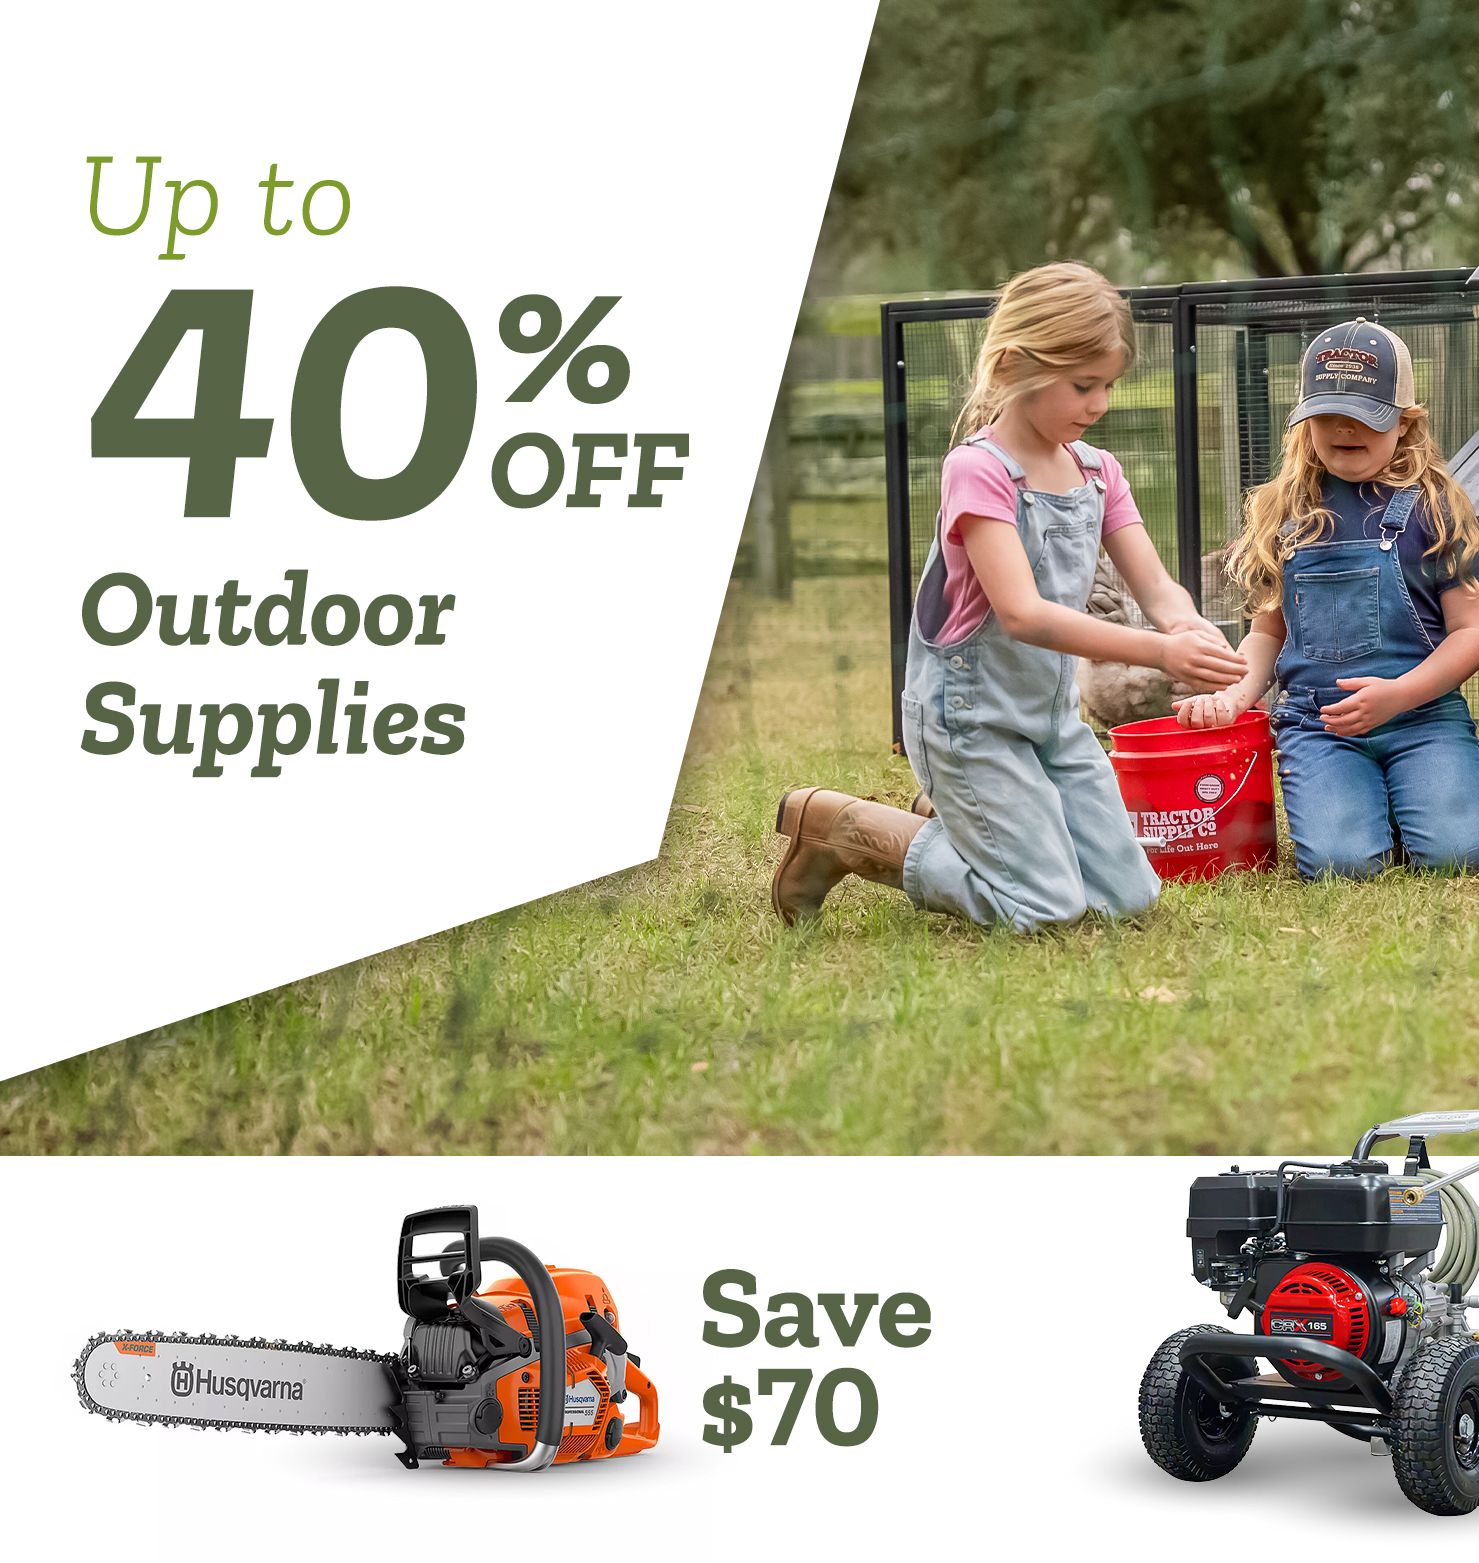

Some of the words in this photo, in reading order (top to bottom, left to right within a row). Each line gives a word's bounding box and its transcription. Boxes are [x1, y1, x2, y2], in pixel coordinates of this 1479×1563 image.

[1316, 347, 1378, 368] TRACTOR
[1315, 373, 1339, 381] SUPPLY
[1340, 373, 1378, 385] COMPANY
[1140, 807, 1216, 826] TRACTOR
[1143, 824, 1194, 840] SUPPLY
[1176, 844, 1194, 853] Out
[1196, 842, 1219, 851] Here
[1271, 1318, 1307, 1332] CRX
[1307, 1320, 1327, 1331] 165
[121, 1343, 154, 1354] X-FORCE
[195, 1368, 304, 1401] Husqvarna
[568, 1395, 595, 1404] Husqvarna
